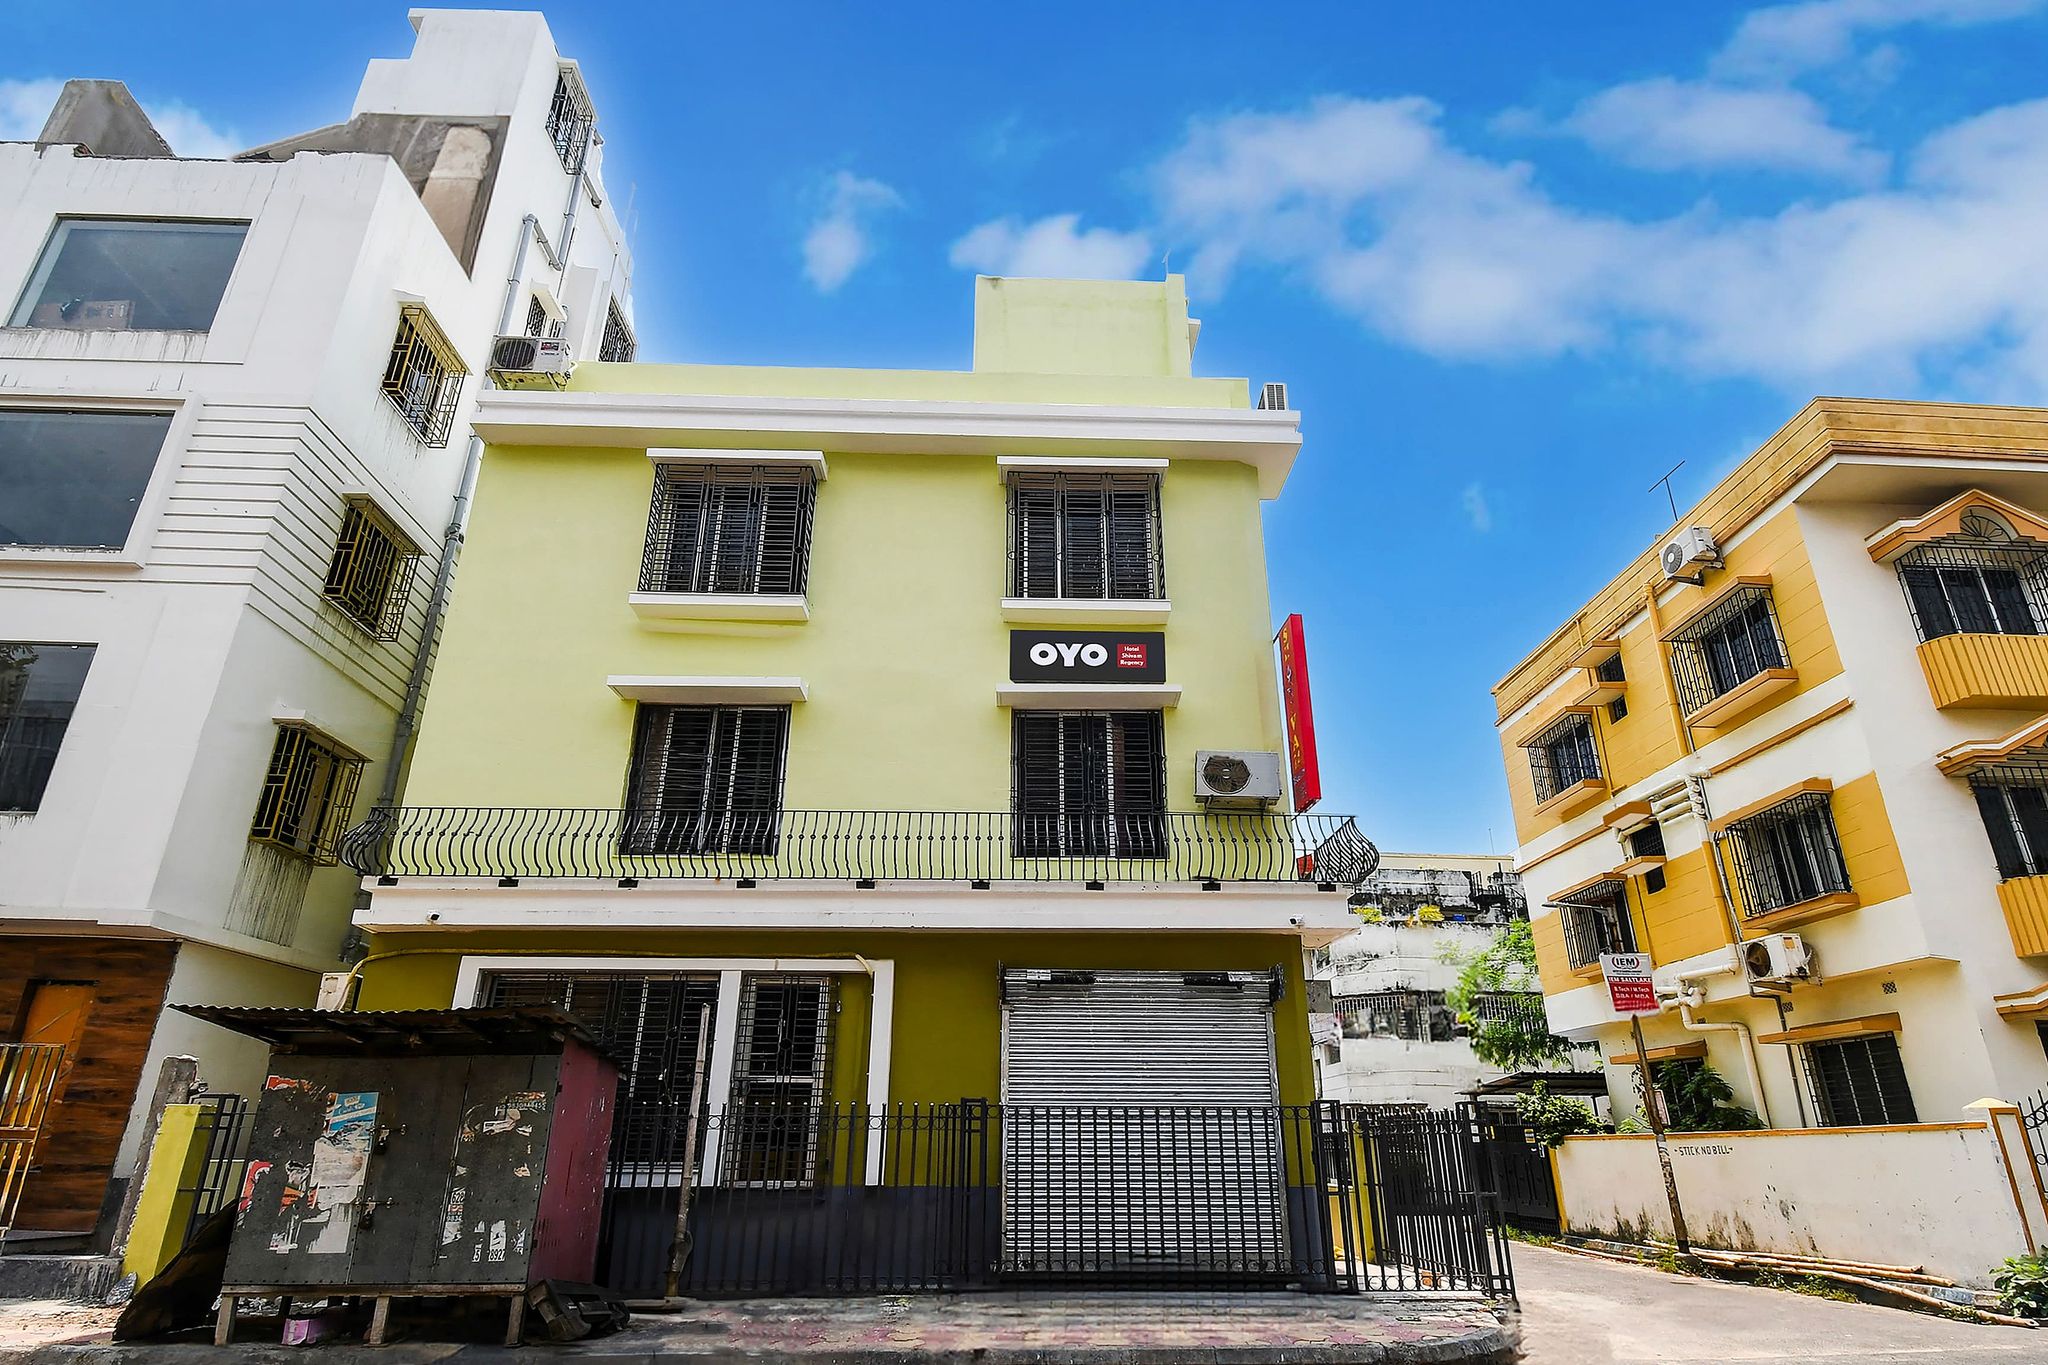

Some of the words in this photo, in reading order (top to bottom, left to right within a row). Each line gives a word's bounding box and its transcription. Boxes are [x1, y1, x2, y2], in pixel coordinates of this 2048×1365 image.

[1029, 642, 1109, 667] OYO
[1615, 957, 1636, 966] IEM
[1679, 1146, 1700, 1156] STICK
[1700, 1145, 1712, 1155] NO
